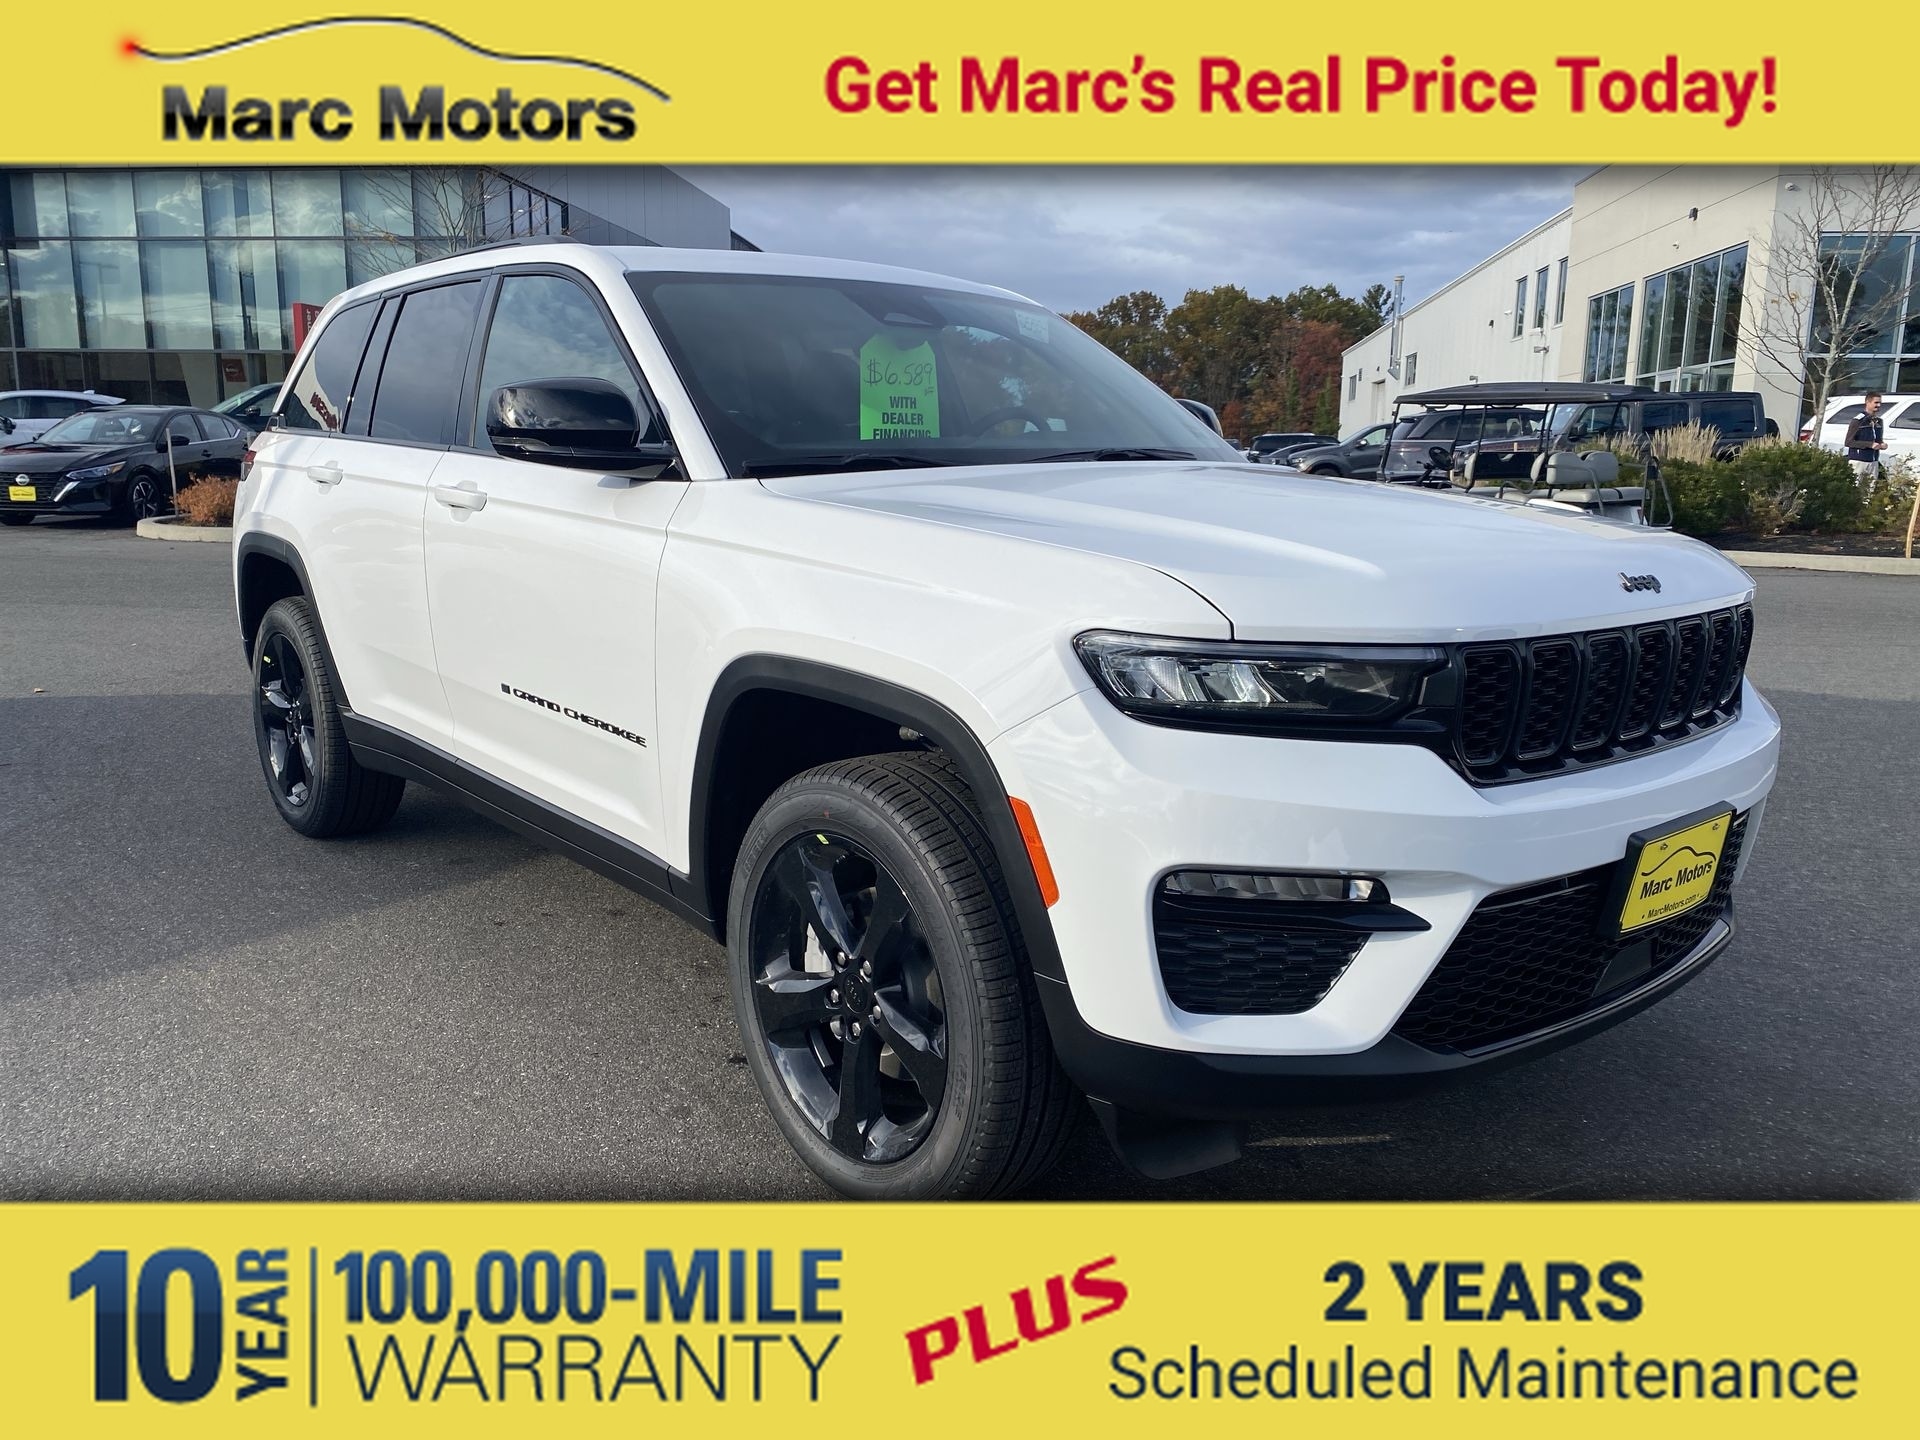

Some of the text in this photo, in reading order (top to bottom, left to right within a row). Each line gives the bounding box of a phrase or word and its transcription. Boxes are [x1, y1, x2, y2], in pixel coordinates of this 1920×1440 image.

[889, 396, 917, 409] WITH
[882, 412, 924, 425] DEALER
[873, 428, 931, 440] FINANCING
[1618, 572, 1661, 594] Jeep
[513, 688, 647, 748] GRAND CHEROKEE
[1640, 860, 1713, 900] Marc Motors
